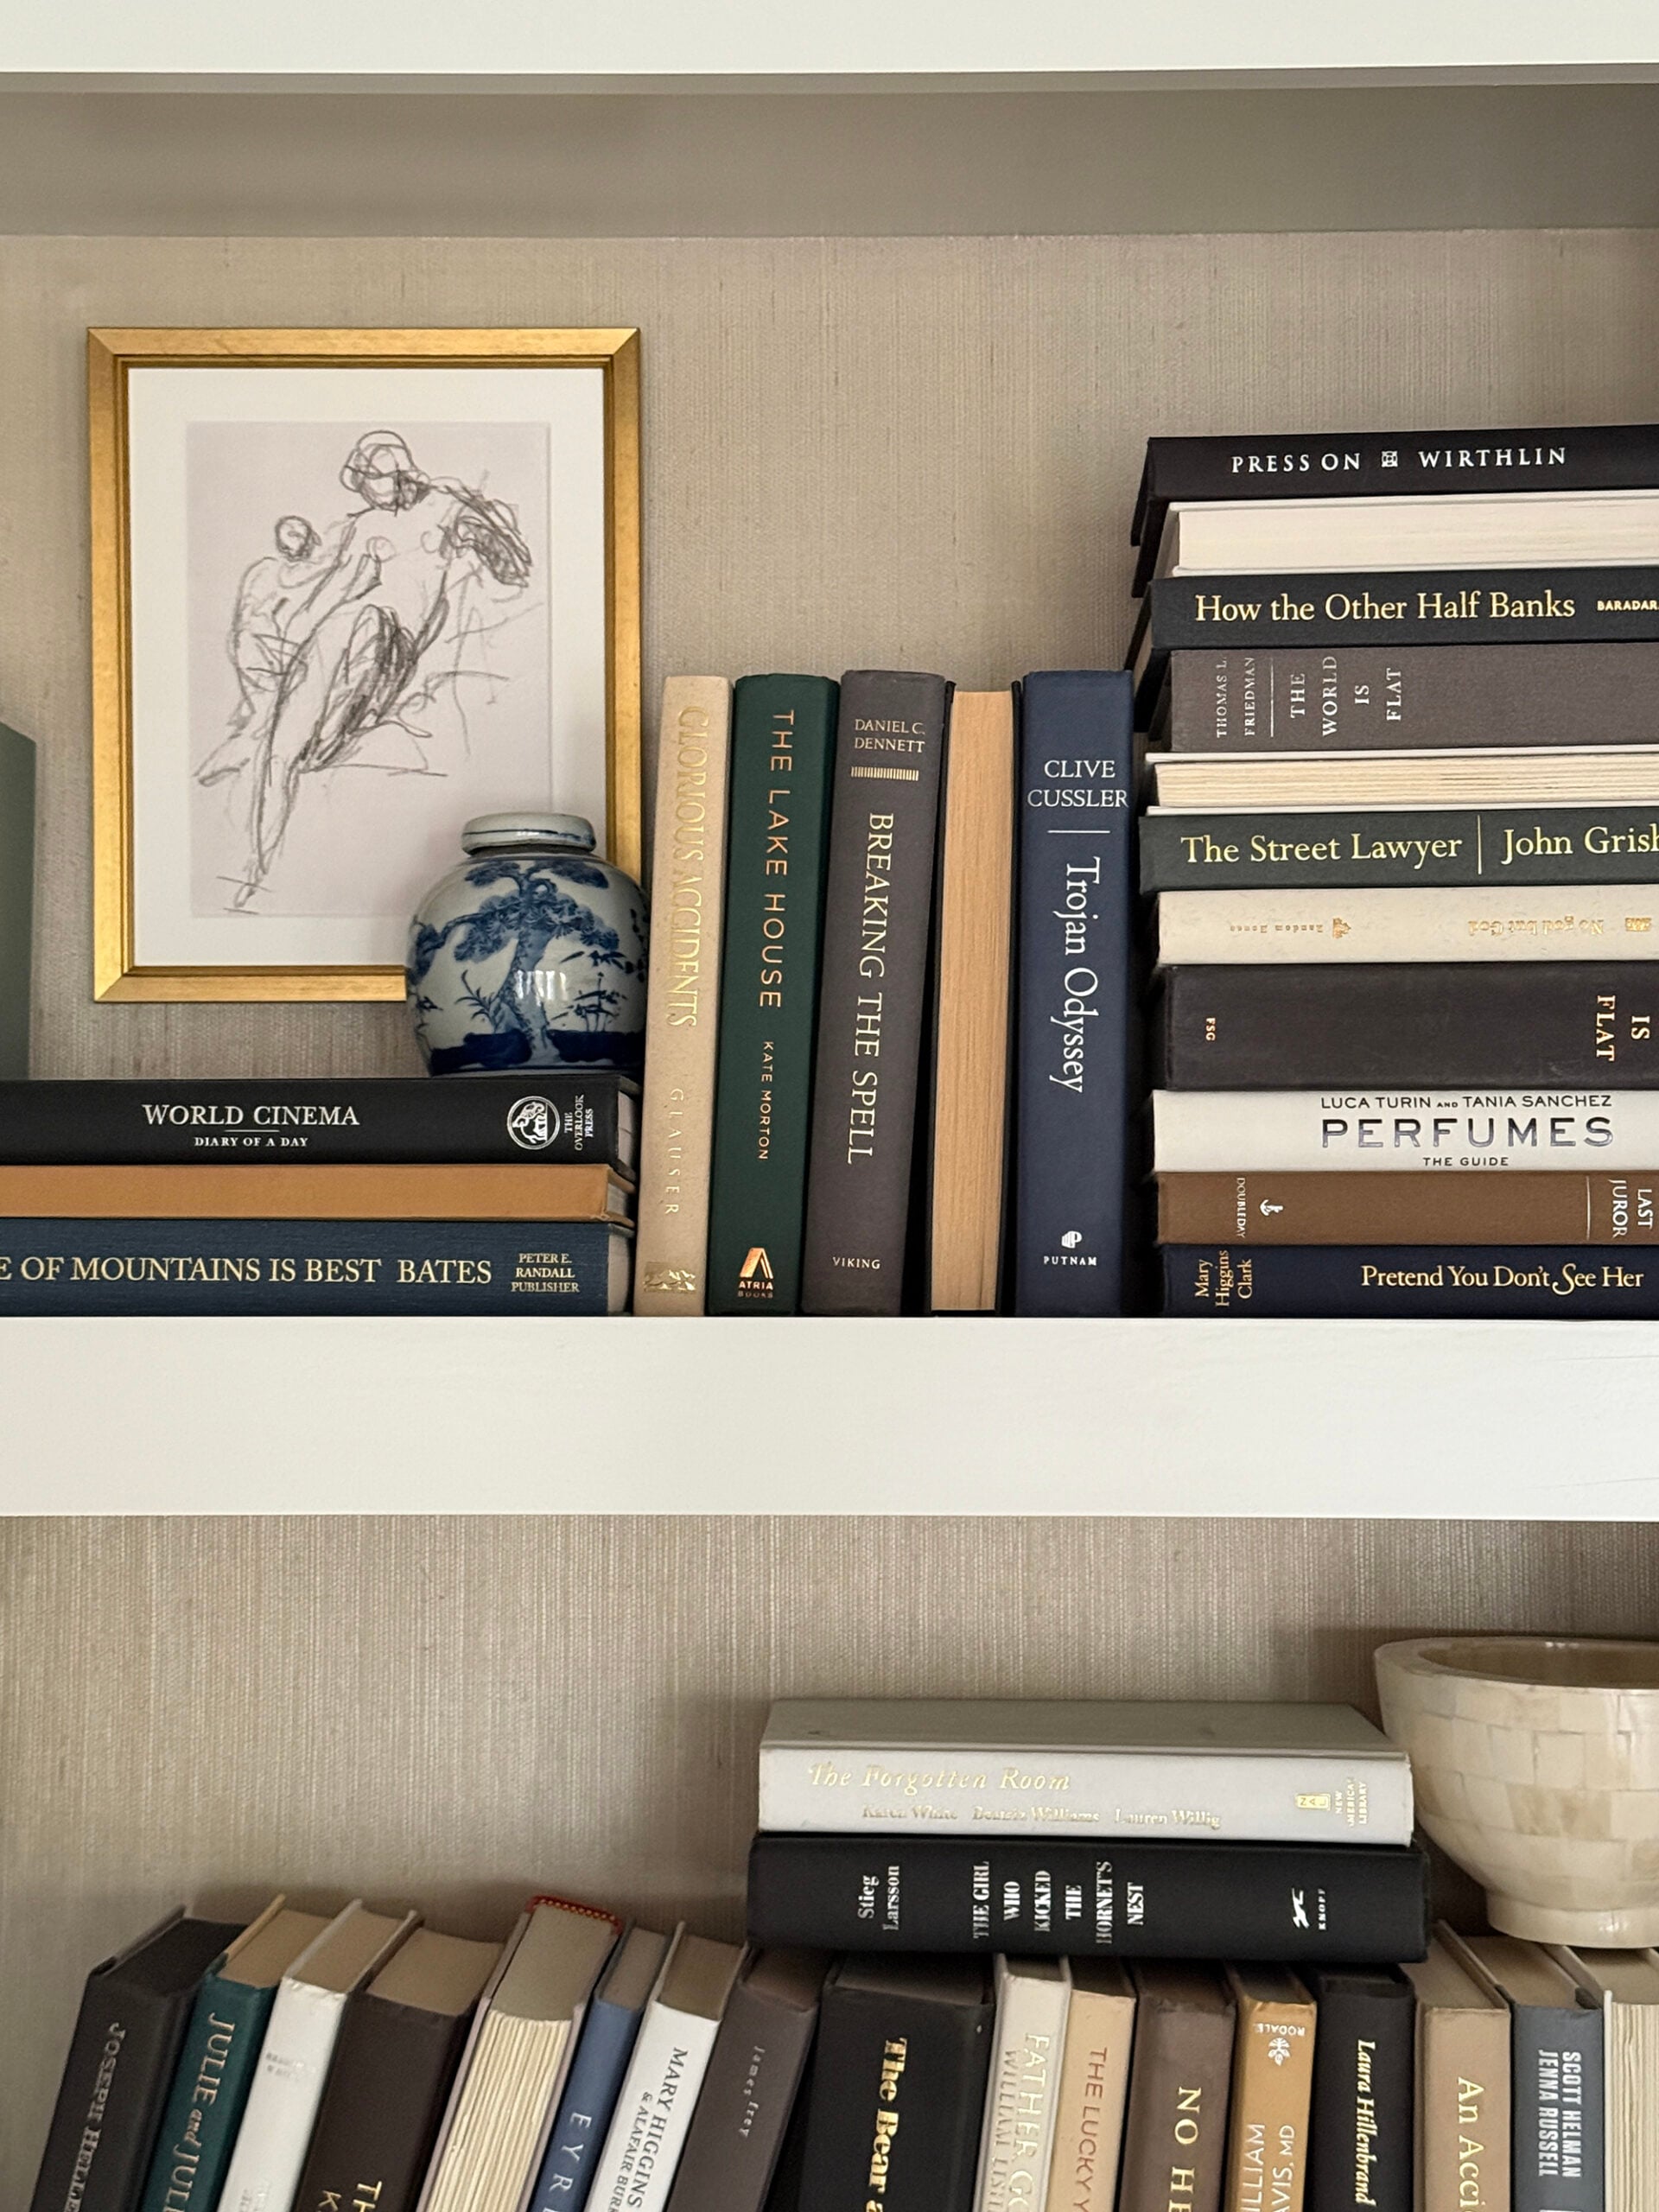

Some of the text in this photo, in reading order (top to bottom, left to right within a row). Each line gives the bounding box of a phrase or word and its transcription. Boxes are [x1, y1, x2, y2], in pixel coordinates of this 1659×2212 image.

[1232, 448, 1565, 473] PRESS ON WIRTHLIN
[1196, 589, 1659, 620] How the Other Half Banks BARADAR
[1216, 671, 1227, 738] THOMAS
[1244, 658, 1255, 735] FRIEDMAN
[1291, 674, 1305, 718] THE
[1323, 657, 1338, 736] WORLD
[1355, 685, 1369, 704] IS
[1387, 668, 1402, 721] FLAT
[855, 719, 909, 733] DANIEL
[855, 738, 925, 753] DENNETT
[1045, 760, 1116, 778] CLIVE
[1028, 790, 1128, 807] CUSSLER
[760, 710, 794, 1007] THE LAKE HOUSE
[1181, 834, 1462, 869] The Street Lawyer
[1501, 827, 1573, 864] John
[666, 707, 709, 1027] GLORIOUS ACCIDENTS
[1468, 921, 1504, 936] God
[1508, 919, 1537, 936] but
[1579, 919, 1604, 934] No
[848, 813, 893, 1164] BREAKING THE SPELL
[1049, 856, 1100, 1092] Trojan Odyssey
[1206, 1018, 1215, 1040] FSG
[1597, 995, 1615, 1061] FLAT
[1631, 1016, 1649, 1039] IS
[142, 1104, 359, 1125] WORLD CINEMA
[759, 1042, 773, 1159] KATE MORTON
[1321, 1097, 1370, 1109] LUCA
[1375, 1097, 1431, 1108] TURIN
[1462, 1096, 1516, 1107] TANIA
[1522, 1095, 1611, 1107] SANCHEZ
[194, 1137, 308, 1147] DIARY OF A DAY
[564, 1113, 573, 1133] THE
[575, 1095, 584, 1150] OVERLOOK
[584, 1109, 593, 1137] PRESS
[1323, 1117, 1611, 1147] PERFUMES
[665, 1088, 683, 1214] GLAUSER
[1423, 1157, 1508, 1166] THE GUIDE
[1237, 1178, 1246, 1237] DOUBLEDAY
[1609, 1179, 1628, 1237] JUROR
[1638, 1189, 1653, 1229] LAST
[21, 1257, 64, 1280] OF
[70, 1257, 260, 1281] MOUNTAINS
[269, 1259, 296, 1281] IS
[304, 1259, 381, 1282] BEST
[397, 1260, 491, 1283] BATES
[516, 1268, 575, 1278] RANDALL
[519, 1253, 558, 1263] PETER
[833, 1257, 880, 1269] VIKING
[1044, 1256, 1096, 1266] PUTNAM
[1215, 1250, 1231, 1306] Higgins
[512, 1281, 580, 1293] PUBLISHER
[739, 1281, 773, 1290] ATRIA
[1195, 1260, 1213, 1297] Mary
[1237, 1259, 1252, 1299] Clark
[1362, 1263, 1643, 1295] Pretend You Don't See Her
[808, 1761, 1071, 1797] The Forgotten Room
[1357, 1782, 1369, 1824] LIBRARY
[858, 1876, 879, 1918] Stieg
[883, 1866, 899, 1929] Larsson
[973, 1862, 989, 1938] THE GIRL
[1004, 1881, 1020, 1920] WHO
[1034, 1871, 1051, 1931] KICKED
[1065, 1885, 1082, 1920] THE
[1127, 1882, 1143, 1925] NEST
[1253, 2023, 1306, 2037] RODALE
[87, 2023, 125, 2122] JOSEPH
[193, 2012, 235, 2105] JULIE
[880, 2037, 906, 2101] The
[1085, 2048, 1107, 2099] THE
[1009, 2033, 1052, 2164] FATHER
[1175, 2087, 1201, 2145] NO
[1539, 2050, 1559, 2176] JENNA RUSSELL
[1562, 2052, 1581, 2177] SCOTT HELMAN
[184, 2109, 201, 2148] and
[620, 2106, 652, 2171] ALAFAIR
[625, 2048, 688, 2208] MARY HIGGINS
[1279, 2126, 1294, 2156] MD
[1355, 2040, 1377, 2206] Laura Hillenbrand
[543, 2113, 592, 2212] EYR
[869, 2109, 899, 2193] Bear
[1076, 2106, 1100, 2192] LUCKY
[1457, 2077, 1486, 2212] An Acci
[608, 2175, 628, 2212] BUR
